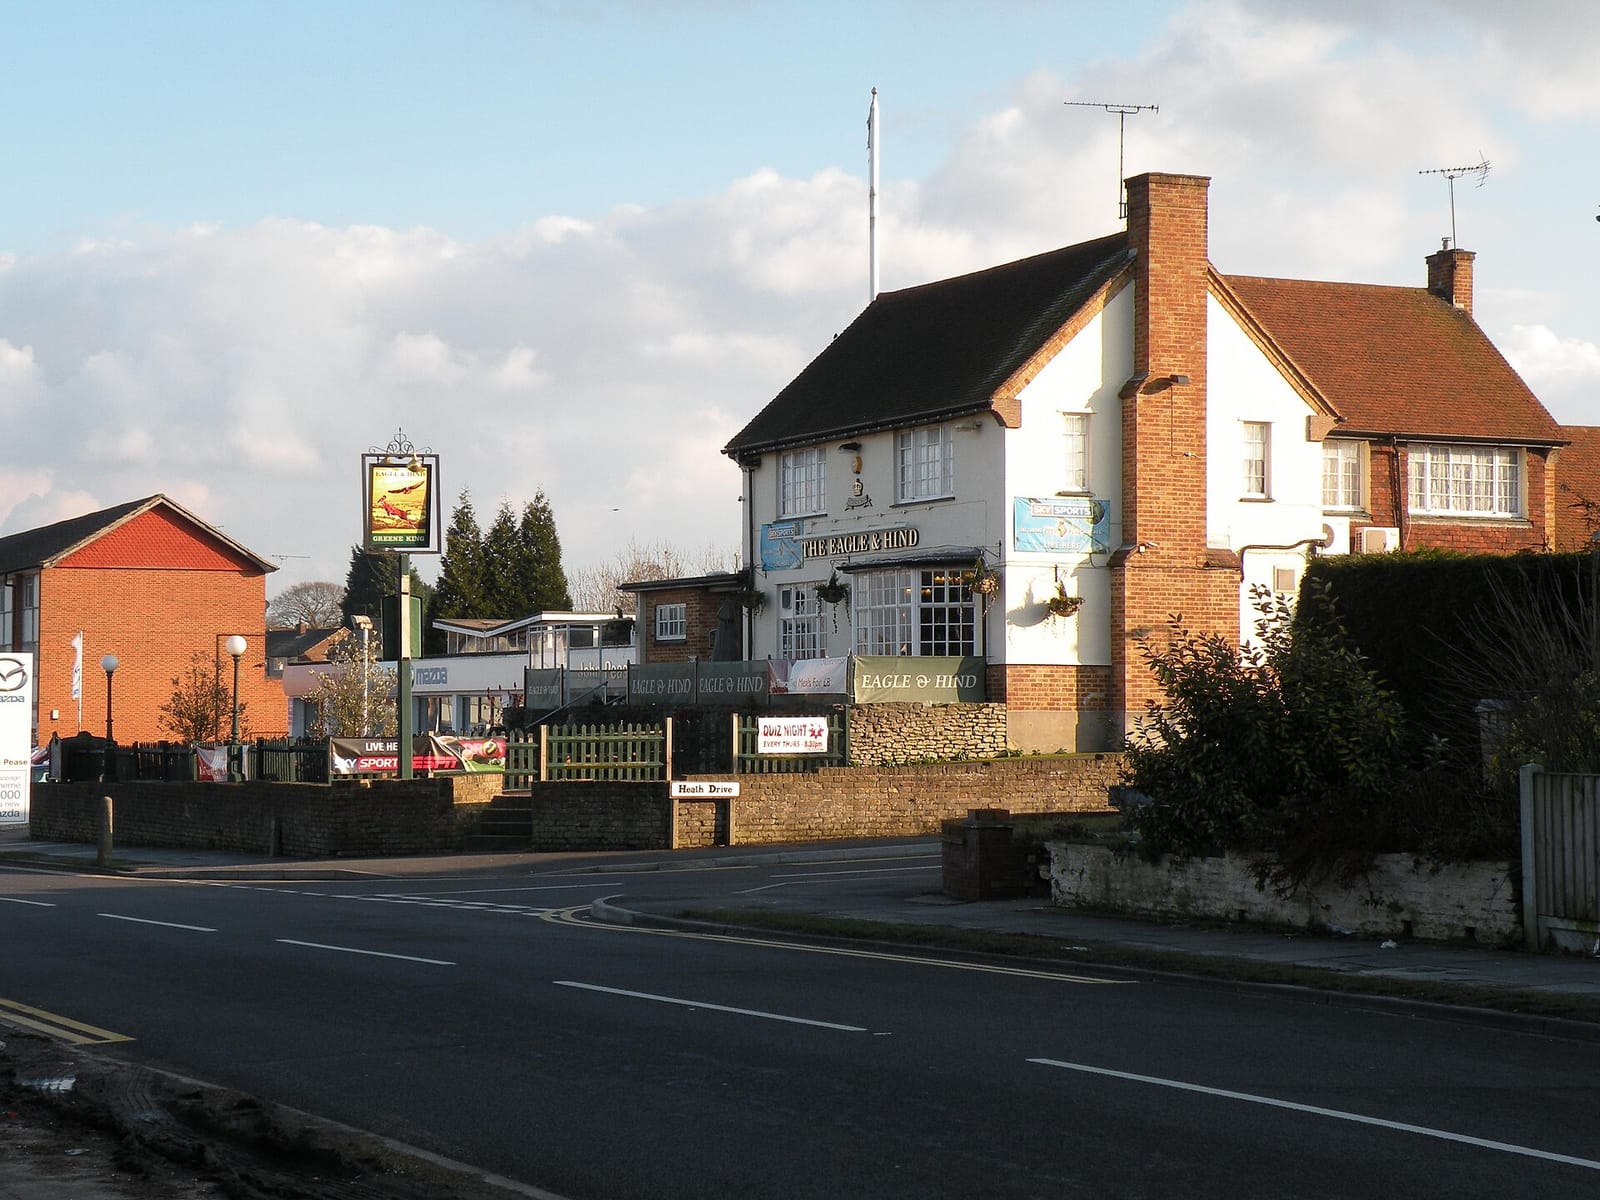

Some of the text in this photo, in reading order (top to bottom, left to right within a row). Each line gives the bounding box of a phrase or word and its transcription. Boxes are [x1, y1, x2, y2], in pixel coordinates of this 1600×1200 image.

[1032, 505, 1091, 515] SKY SPORTS
[802, 529, 919, 558] THE EAGLE & HIND
[632, 679, 655, 694] EAGLE
[667, 678, 692, 693] HIND
[700, 677, 724, 693] EAGLE
[736, 676, 763, 692] HIND
[861, 674, 977, 689] EAGLE & HIND
[763, 724, 807, 737] QUIZ NIGHT
[366, 742, 398, 752] LIVE HE
[763, 740, 781, 748] EVERY
[360, 758, 398, 768] SPORT
[679, 784, 733, 794] Heath Drive
